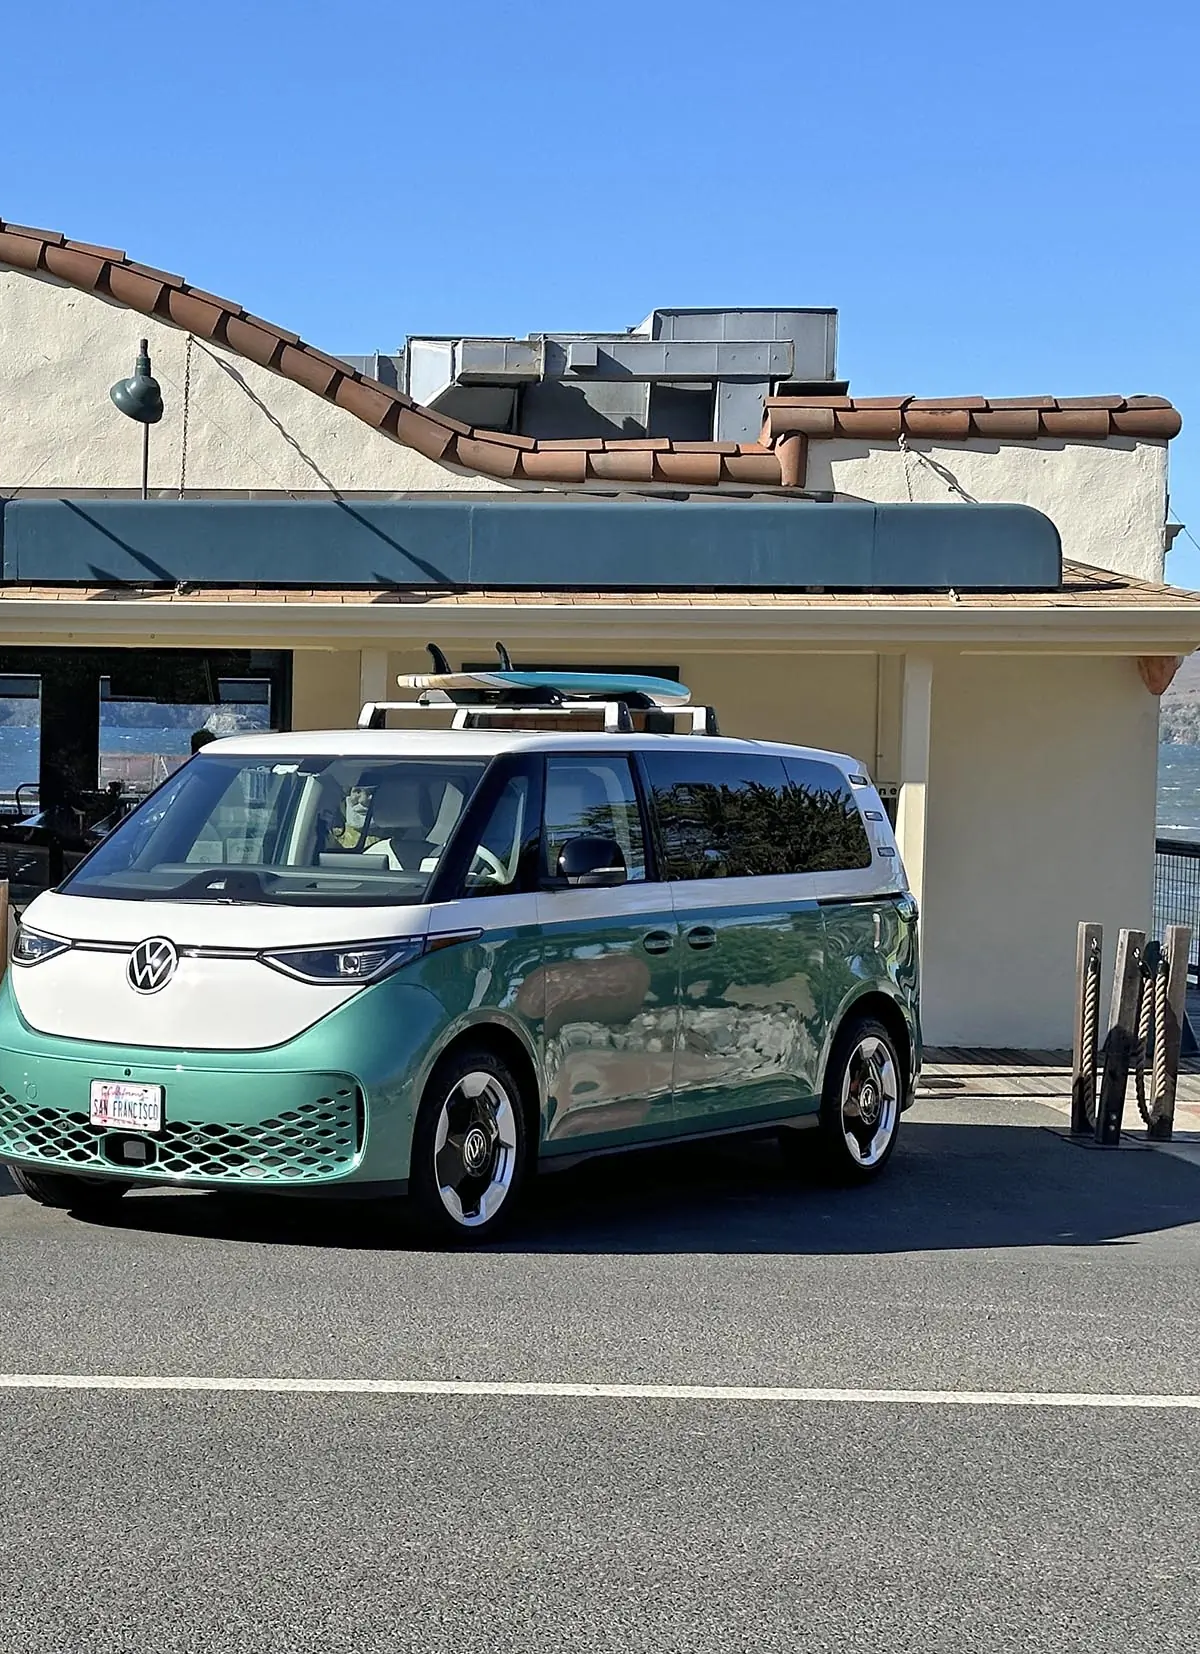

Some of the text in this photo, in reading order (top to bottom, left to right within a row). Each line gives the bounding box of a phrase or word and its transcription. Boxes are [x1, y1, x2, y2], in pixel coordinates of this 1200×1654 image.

[127, 936, 177, 994] VW
[93, 1098, 159, 1121] SAN FRANCISCO
